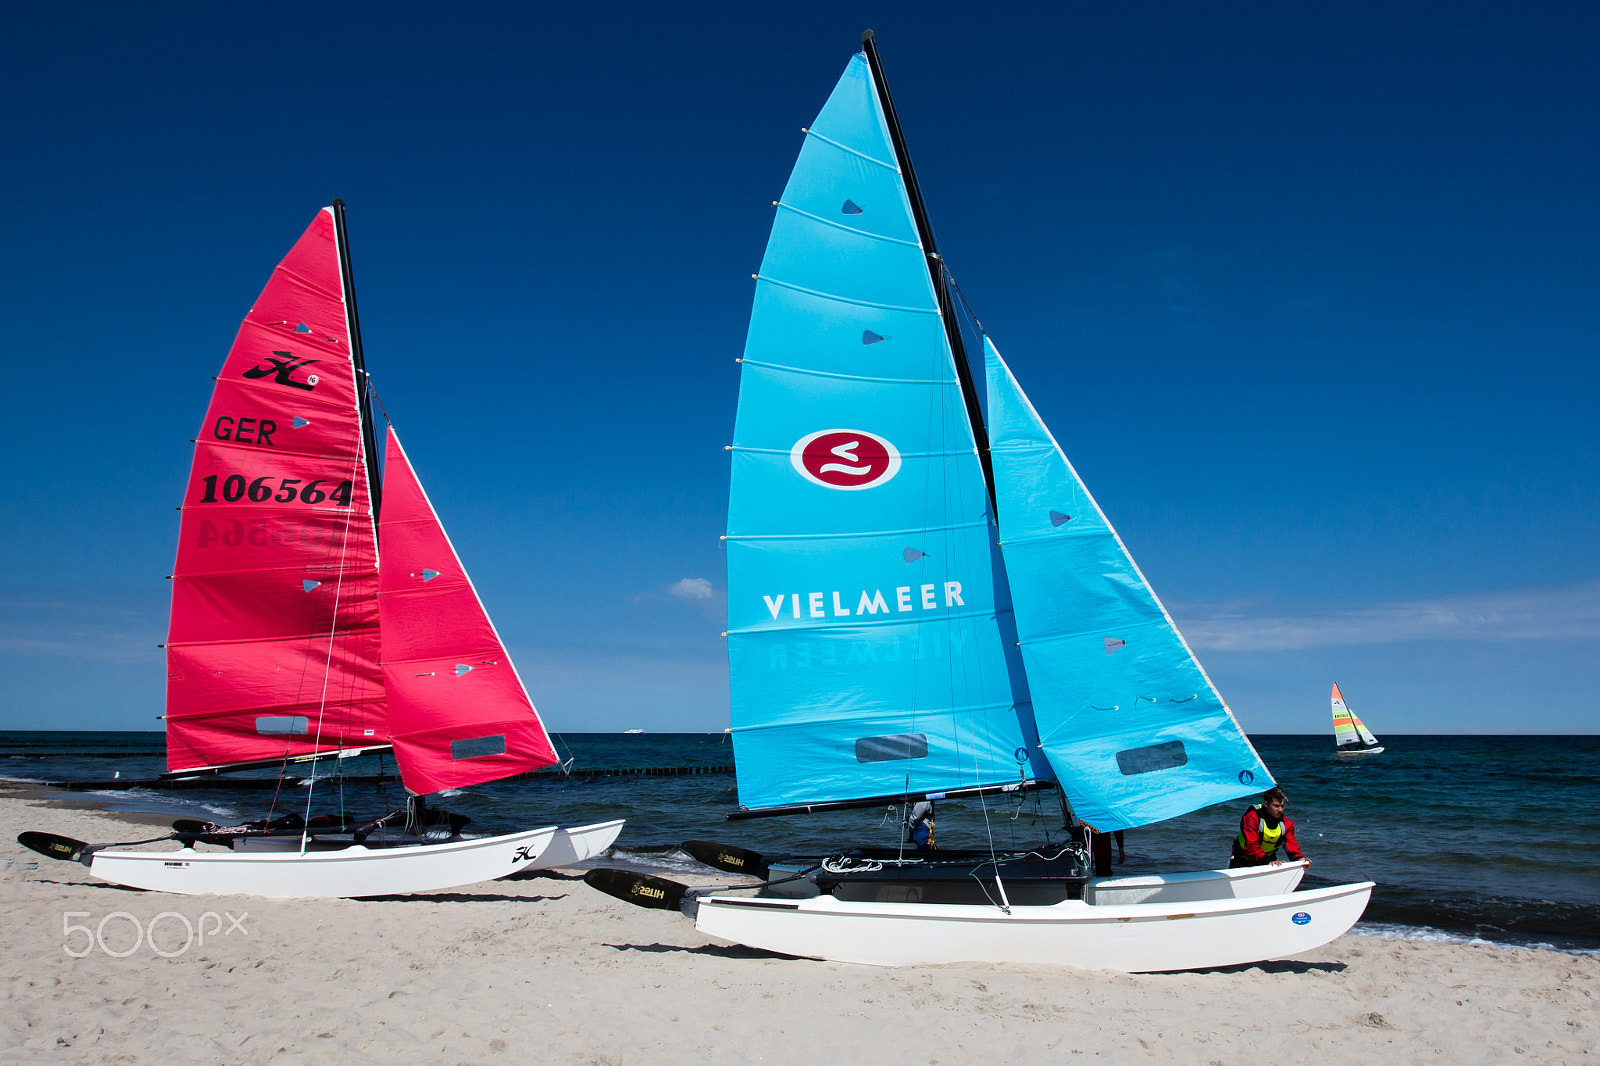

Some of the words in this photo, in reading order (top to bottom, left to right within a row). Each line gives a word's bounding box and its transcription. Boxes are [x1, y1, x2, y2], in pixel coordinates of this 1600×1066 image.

[213, 415, 277, 446] GER
[199, 474, 354, 506] 106564
[763, 580, 965, 620] VIELMEER
